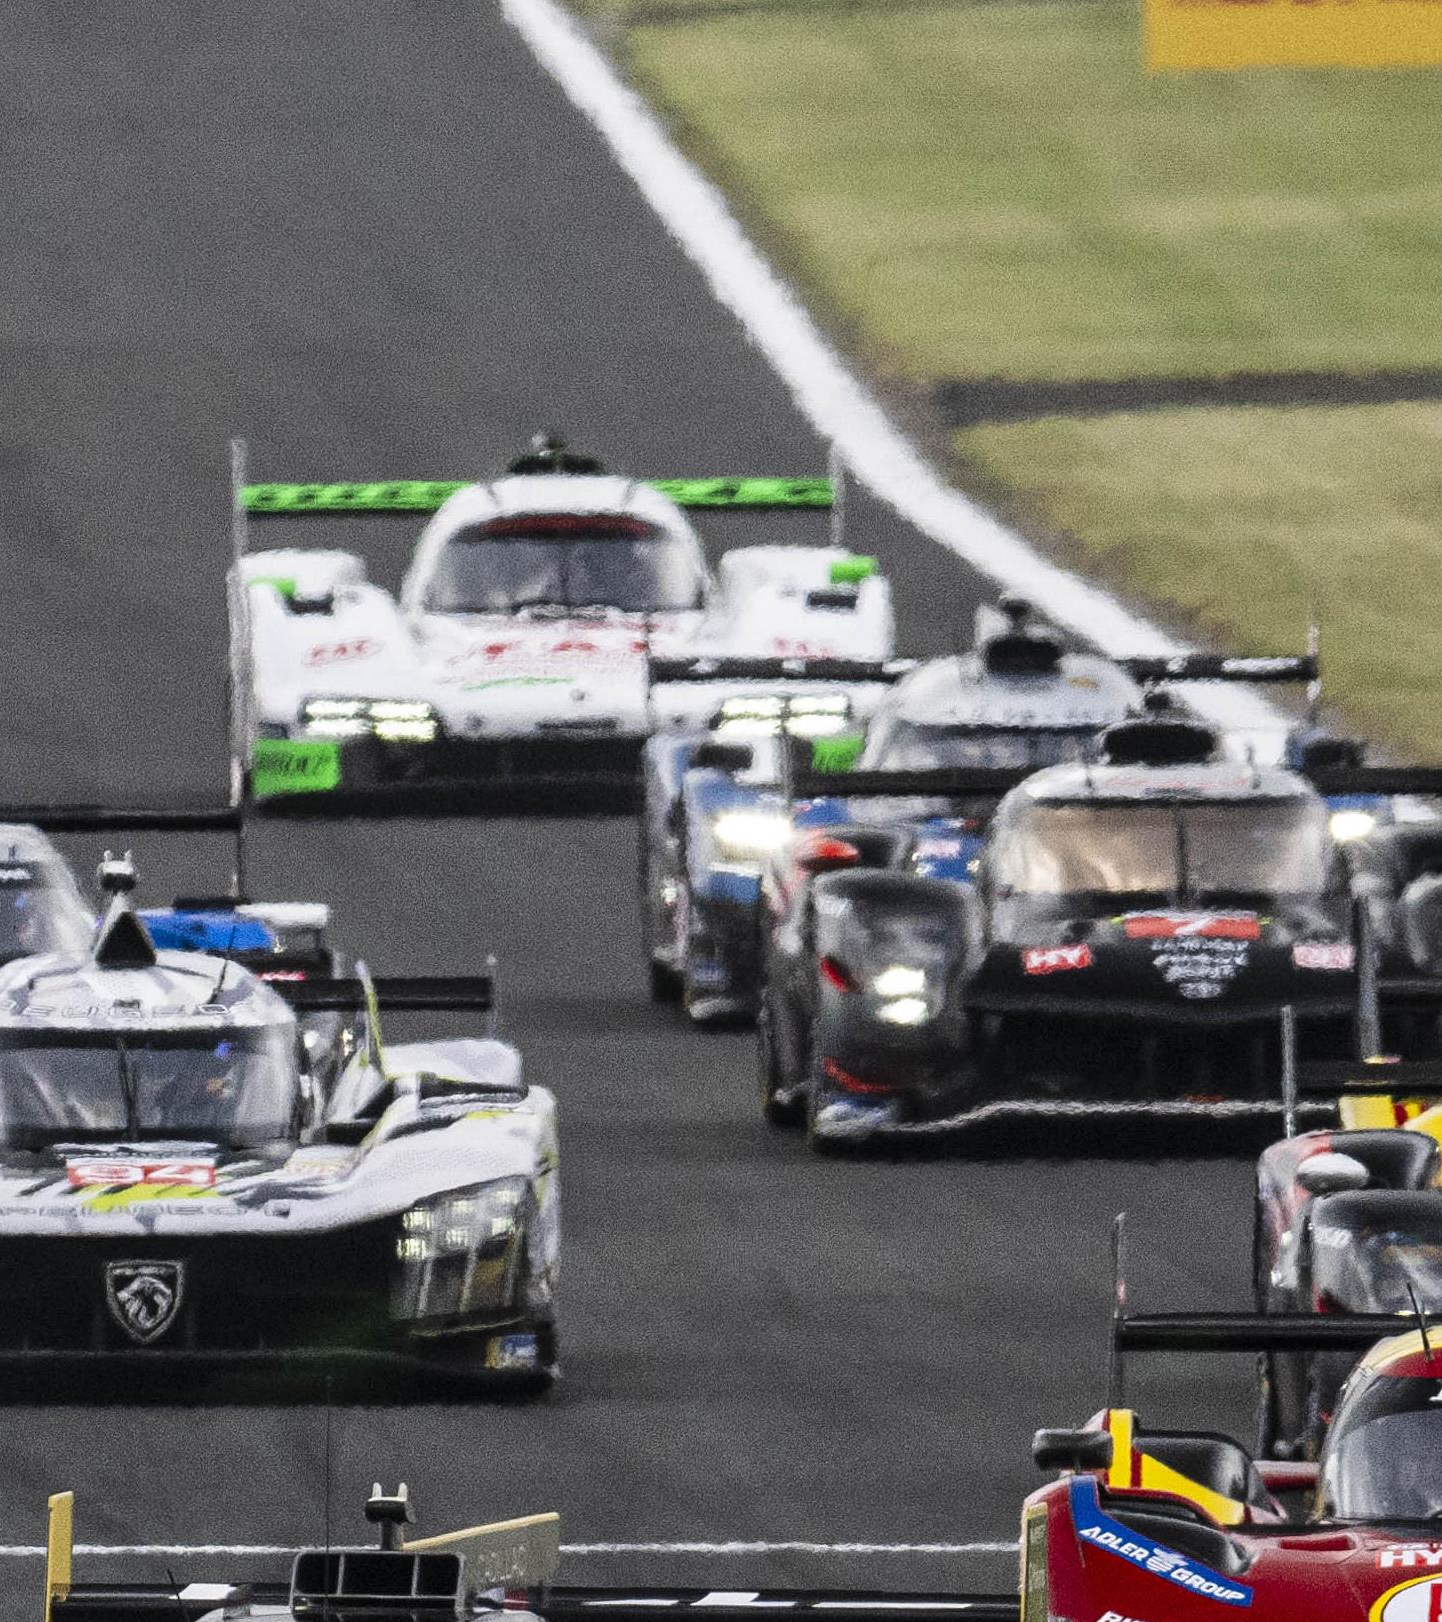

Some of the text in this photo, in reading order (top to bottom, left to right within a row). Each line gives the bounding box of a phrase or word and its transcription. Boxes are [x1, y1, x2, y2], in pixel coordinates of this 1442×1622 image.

[75, 1166, 212, 1185] 94
[1078, 1526, 1245, 1602] ADLER GROUP
